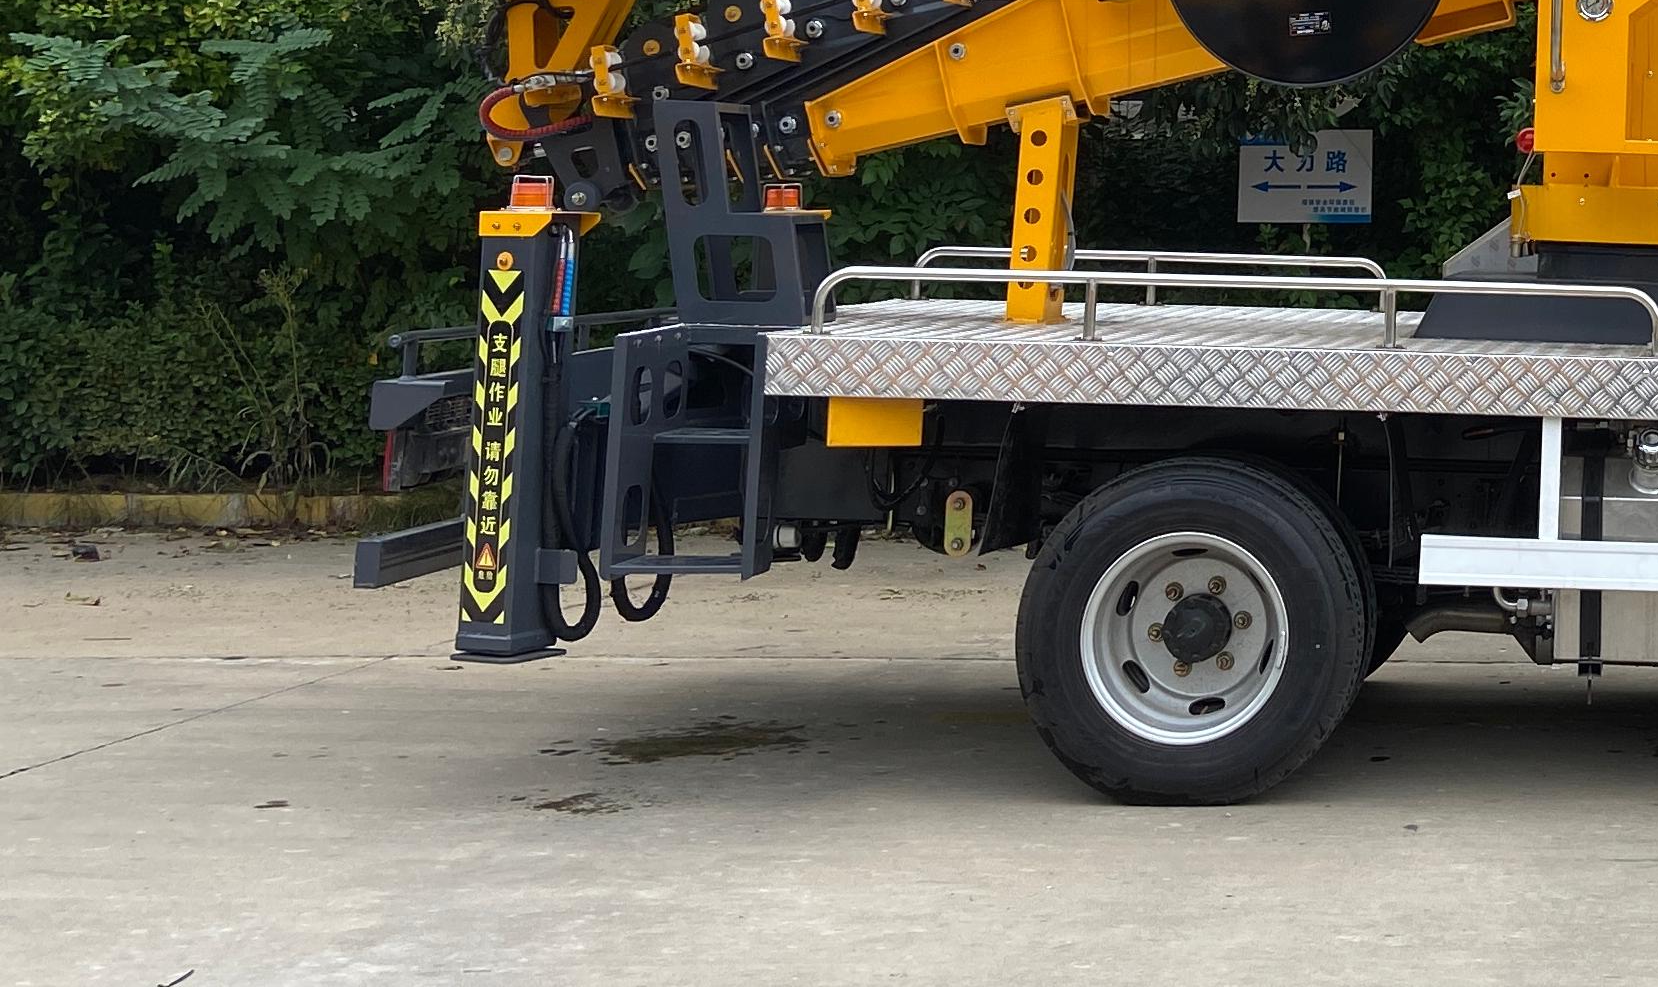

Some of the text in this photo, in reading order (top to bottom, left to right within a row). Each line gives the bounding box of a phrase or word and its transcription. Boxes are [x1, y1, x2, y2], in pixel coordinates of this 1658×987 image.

[480, 332, 507, 535] 支腿作业 请勿靠近
